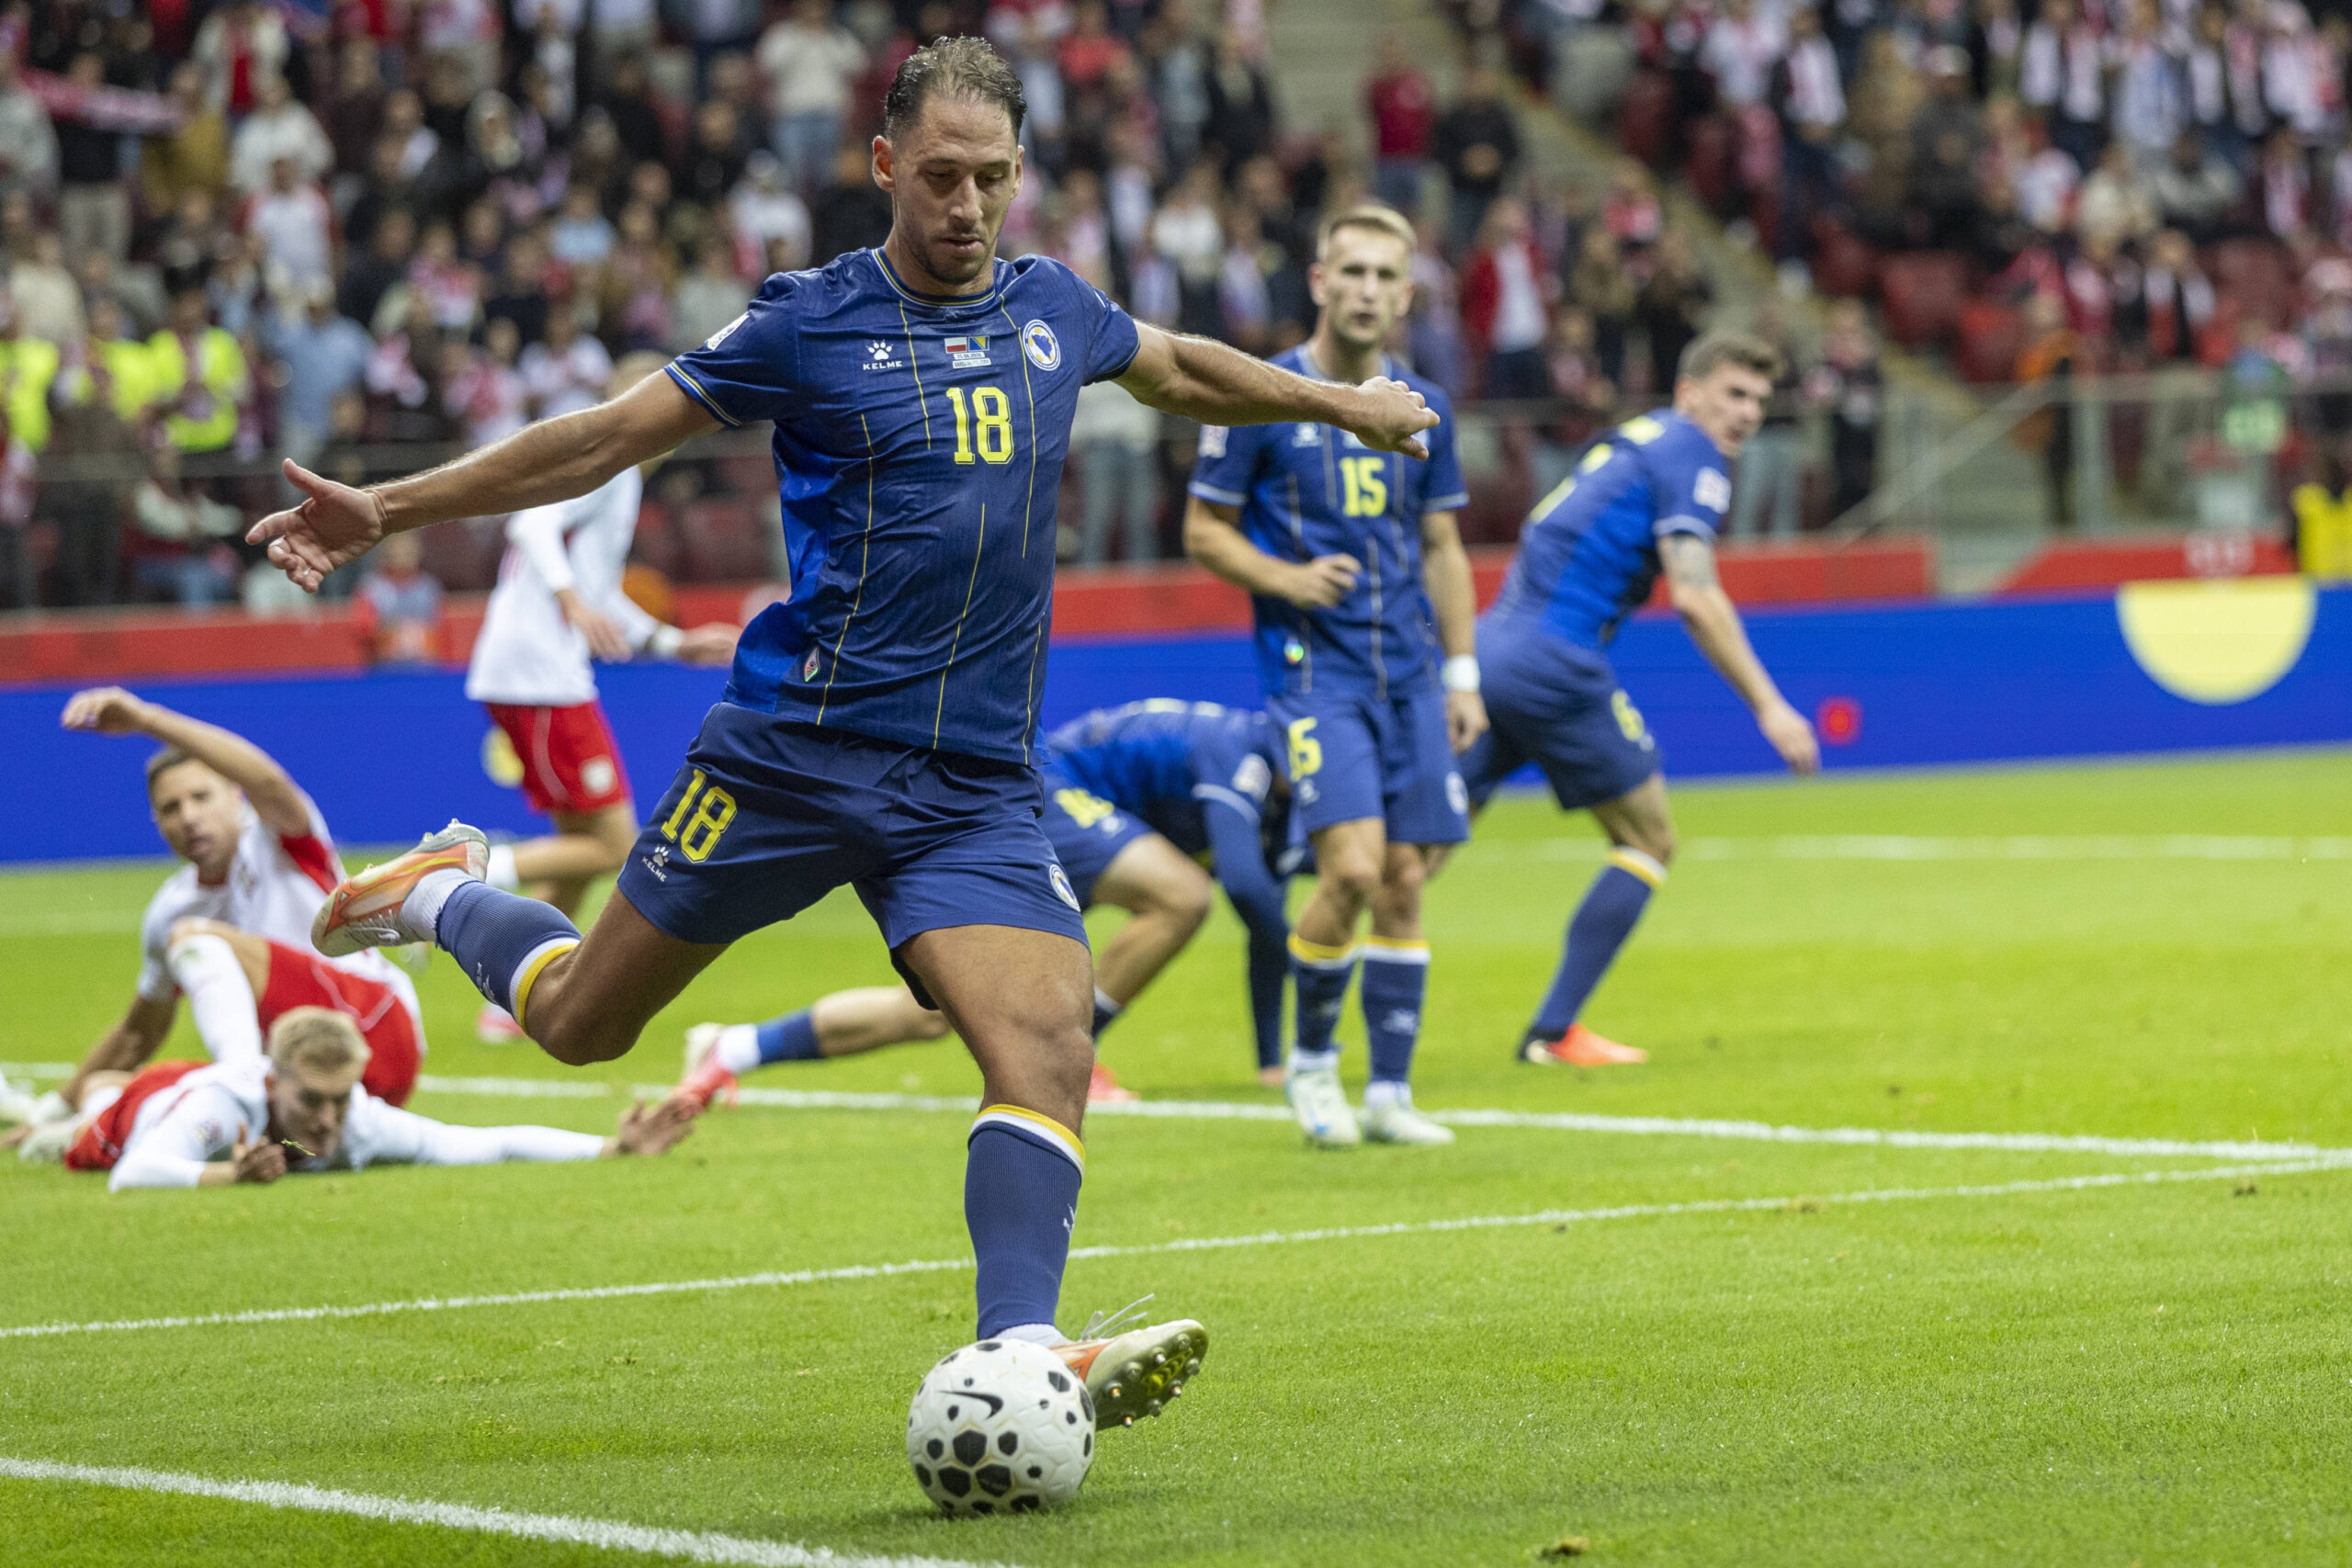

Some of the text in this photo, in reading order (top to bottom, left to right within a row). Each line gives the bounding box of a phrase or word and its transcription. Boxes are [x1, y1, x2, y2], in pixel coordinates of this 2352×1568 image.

[863, 360, 902, 370] KELME
[945, 387, 1014, 465] 18
[1339, 457, 1387, 517] 15
[661, 769, 737, 863] 18
[642, 856, 667, 883] KELME
